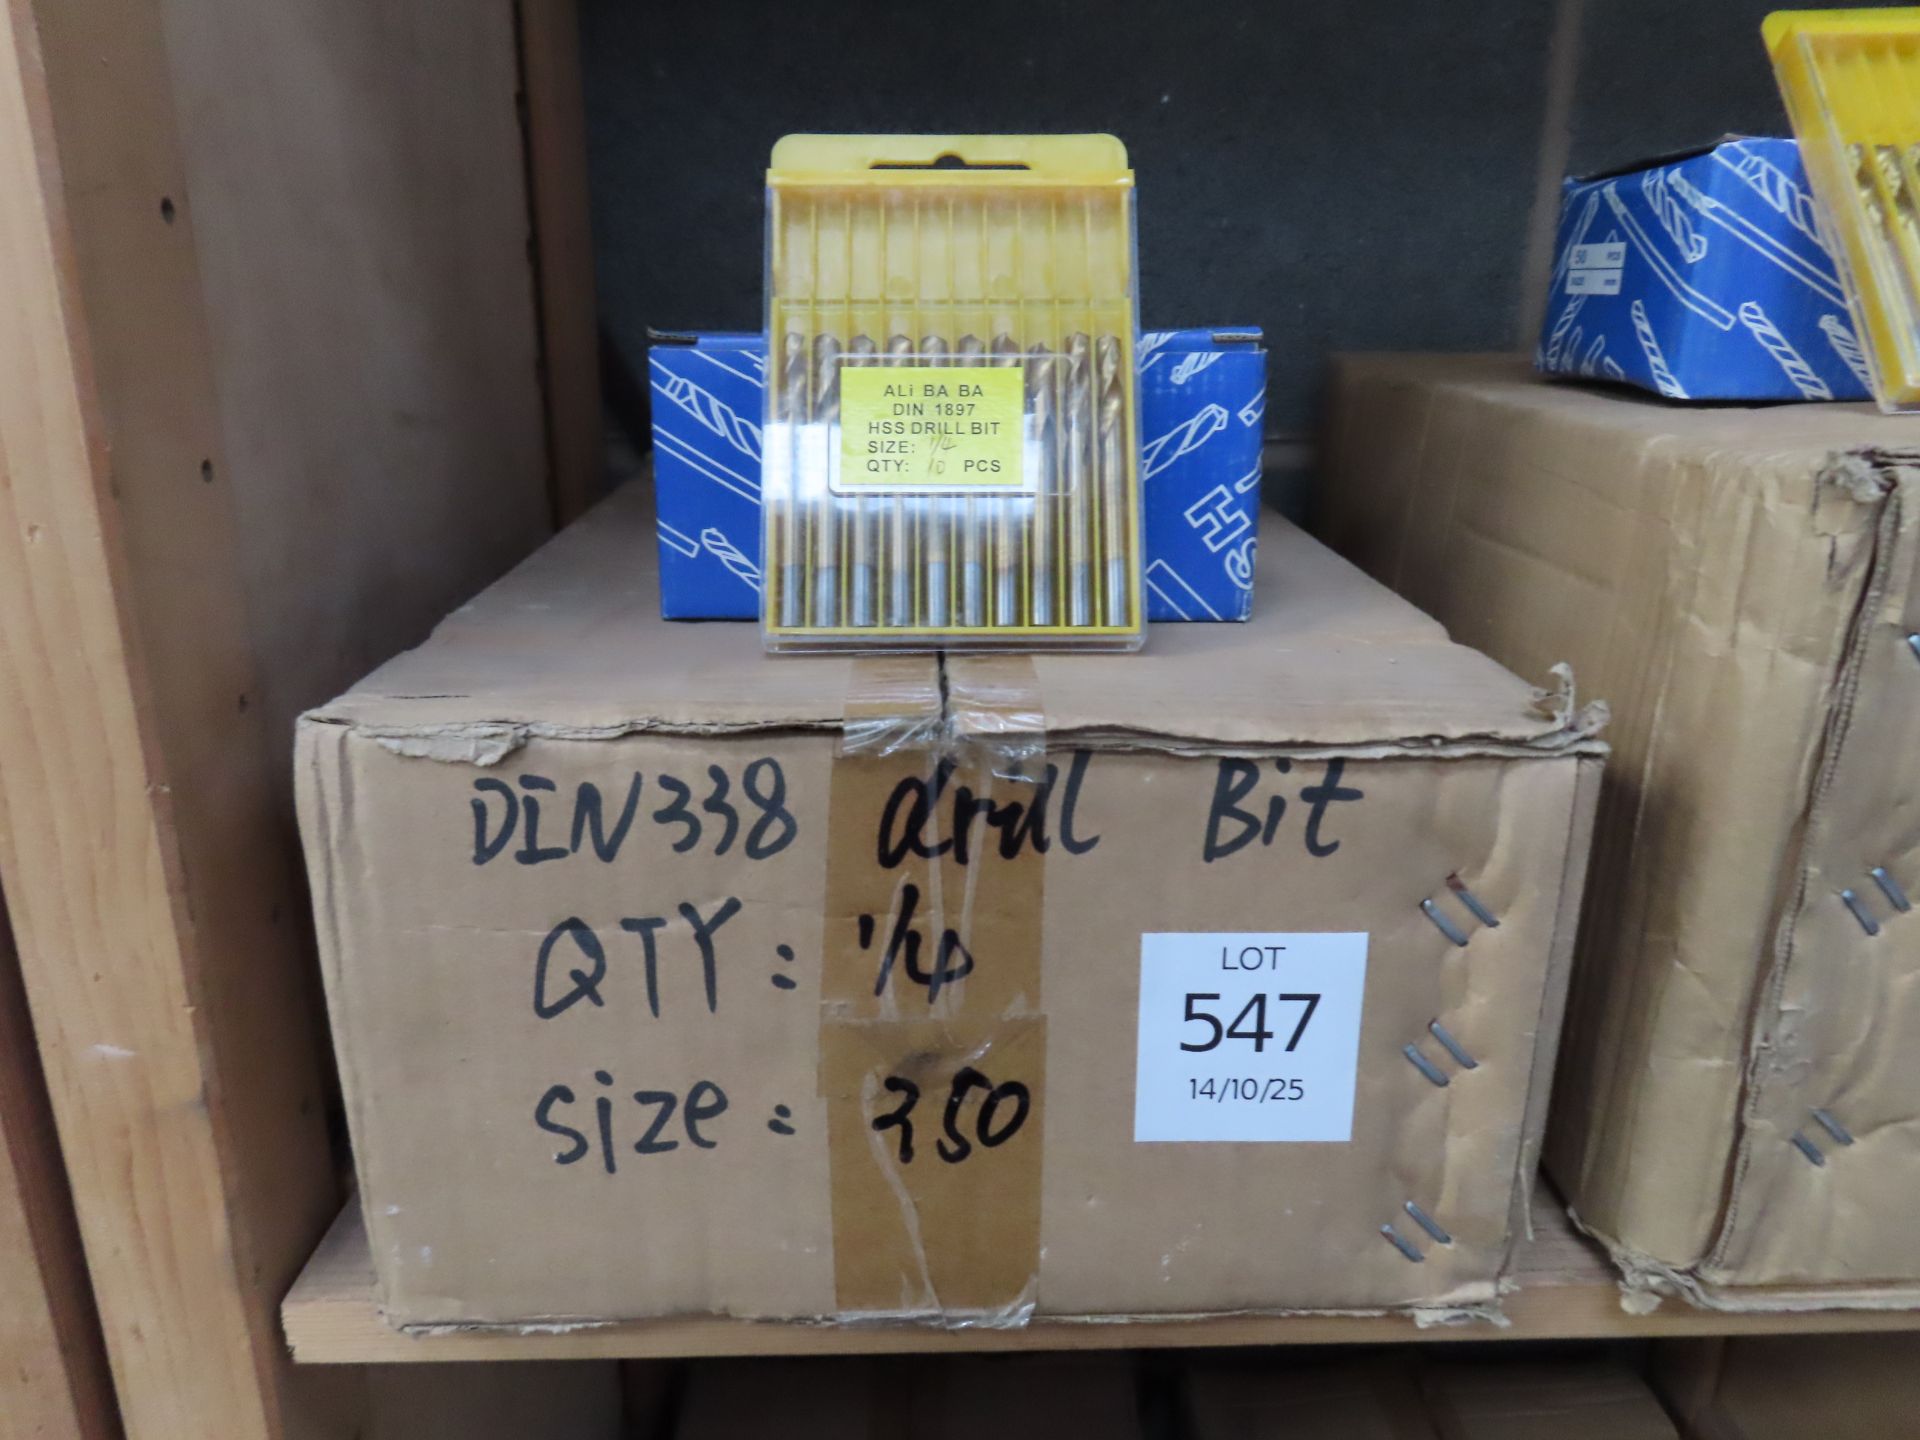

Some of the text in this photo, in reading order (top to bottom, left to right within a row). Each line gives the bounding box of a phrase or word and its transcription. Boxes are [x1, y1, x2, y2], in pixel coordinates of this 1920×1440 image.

[884, 384, 984, 397] ALi BA BA
[893, 403, 976, 416] DIN 1897
[868, 421, 1001, 435] HSS DRILL BIT
[867, 440, 915, 454] SIZE:
[867, 459, 909, 472] QTY:
[964, 459, 1001, 472] PCS
[1203, 757, 1364, 863] Bit
[1222, 946, 1286, 971] LOT
[1179, 992, 1322, 1053] 547
[1190, 1078, 1305, 1103] 14/10/25
